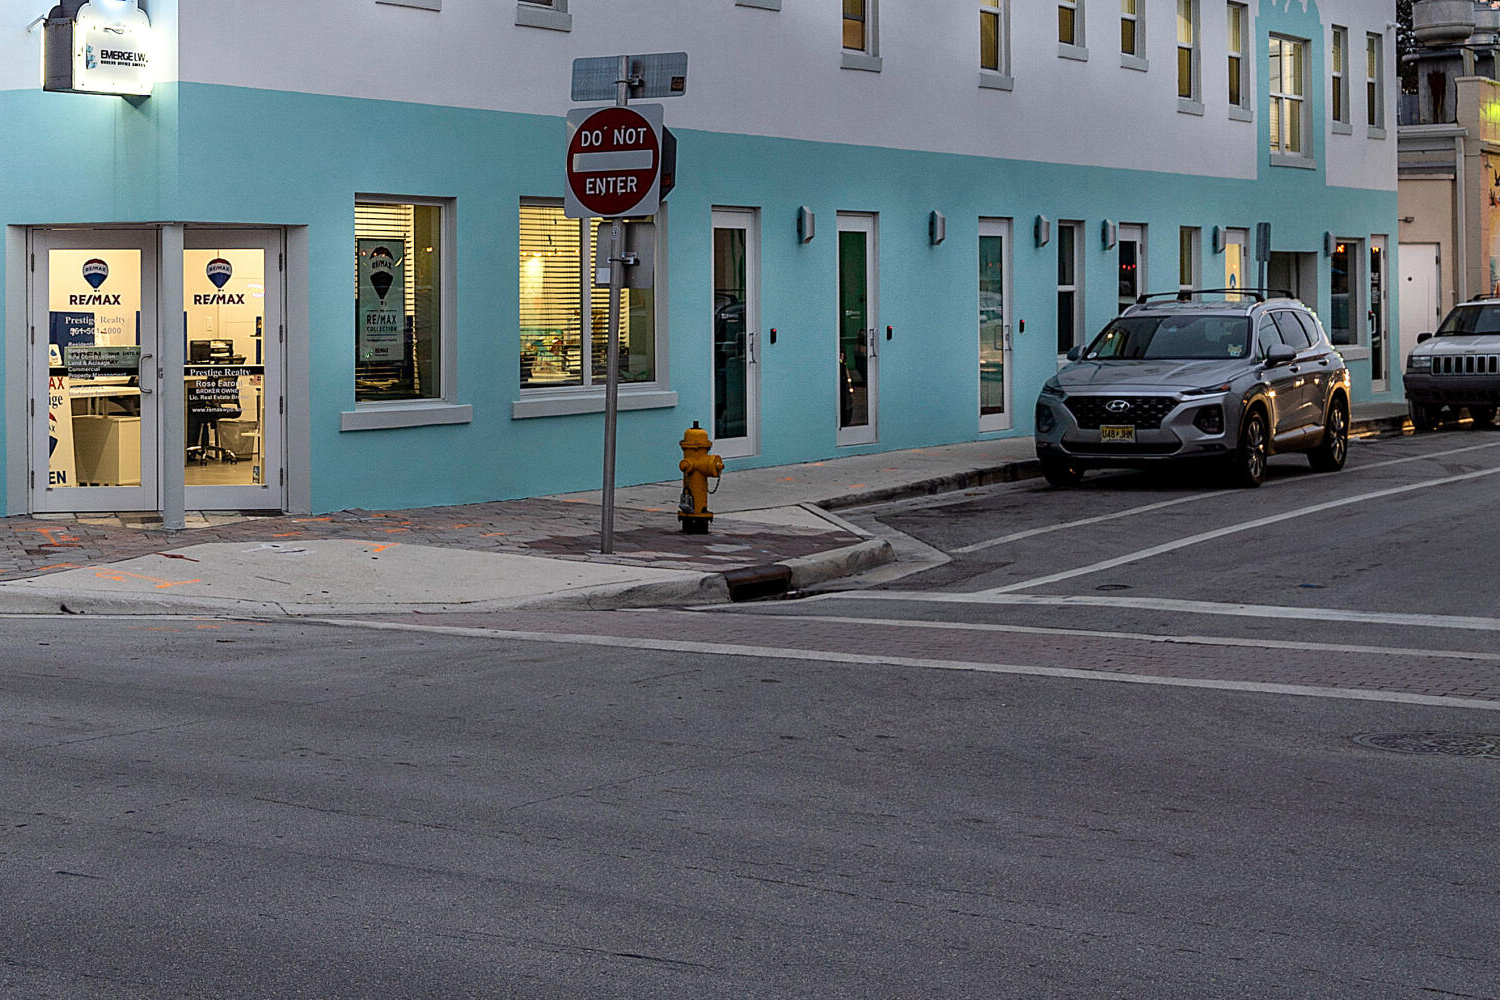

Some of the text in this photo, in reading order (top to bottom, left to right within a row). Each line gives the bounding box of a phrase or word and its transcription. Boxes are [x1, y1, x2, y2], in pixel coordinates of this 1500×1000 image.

[101, 49, 133, 61] EMERGE
[581, 127, 647, 147] DO NOT
[585, 176, 637, 195] ENTER
[371, 260, 392, 269] RE/MAX
[69, 294, 121, 305] RE/MAX
[193, 293, 245, 305] RE/MAX
[100, 316, 125, 326] Realty
[366, 314, 397, 325] RE/MAX
[189, 368, 251, 378] Prestige Realty
